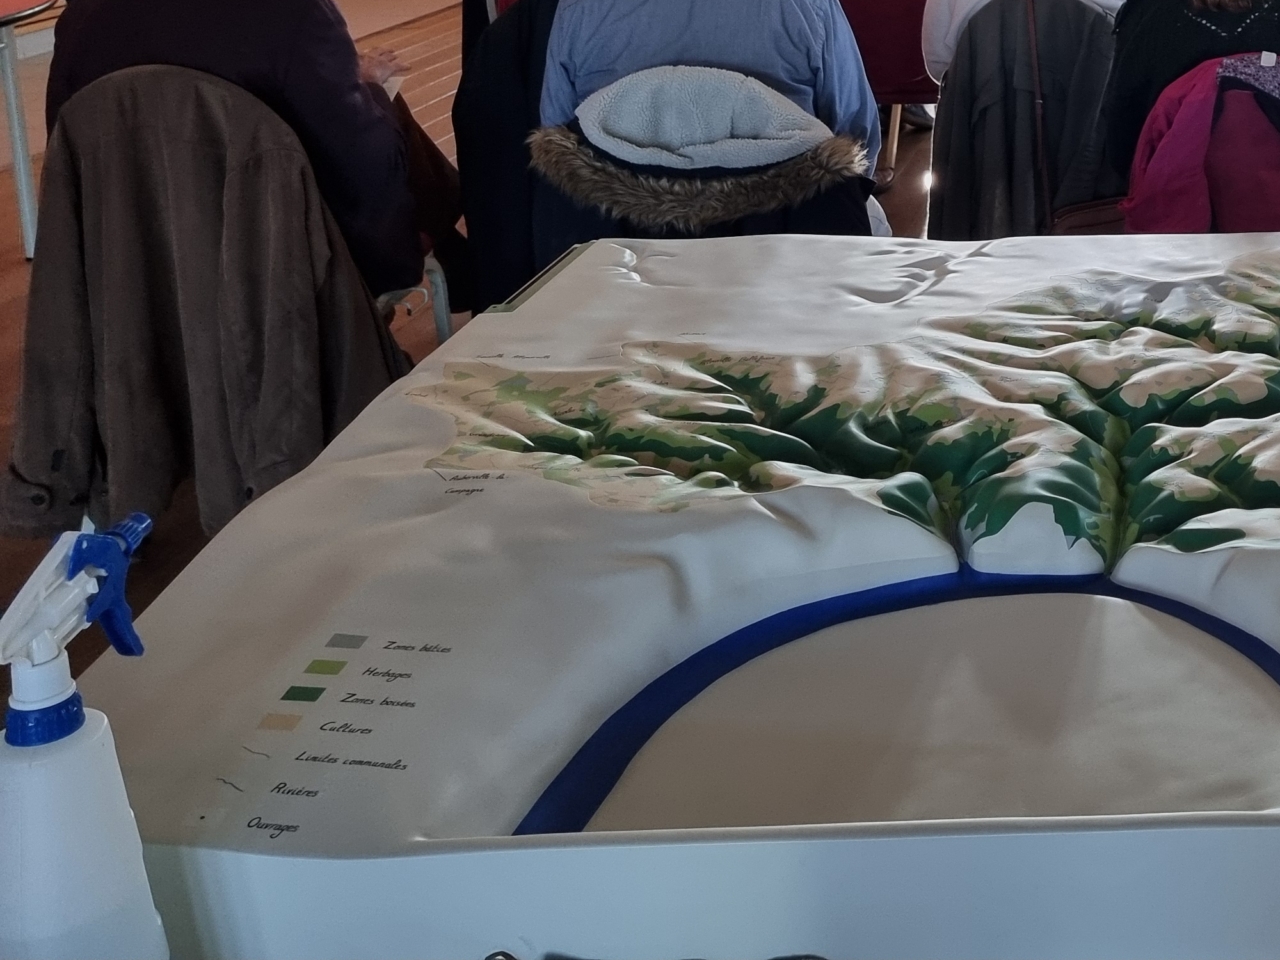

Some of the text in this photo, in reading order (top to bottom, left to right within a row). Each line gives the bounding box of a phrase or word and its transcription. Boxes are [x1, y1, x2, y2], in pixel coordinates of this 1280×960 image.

[382, 641, 452, 653] Zones bâties
[362, 667, 413, 682] Herbages
[339, 693, 416, 708] Zones boisées
[319, 721, 373, 735] Cultures
[294, 751, 408, 770] Limites communales
[247, 816, 300, 839] Ouvrages
